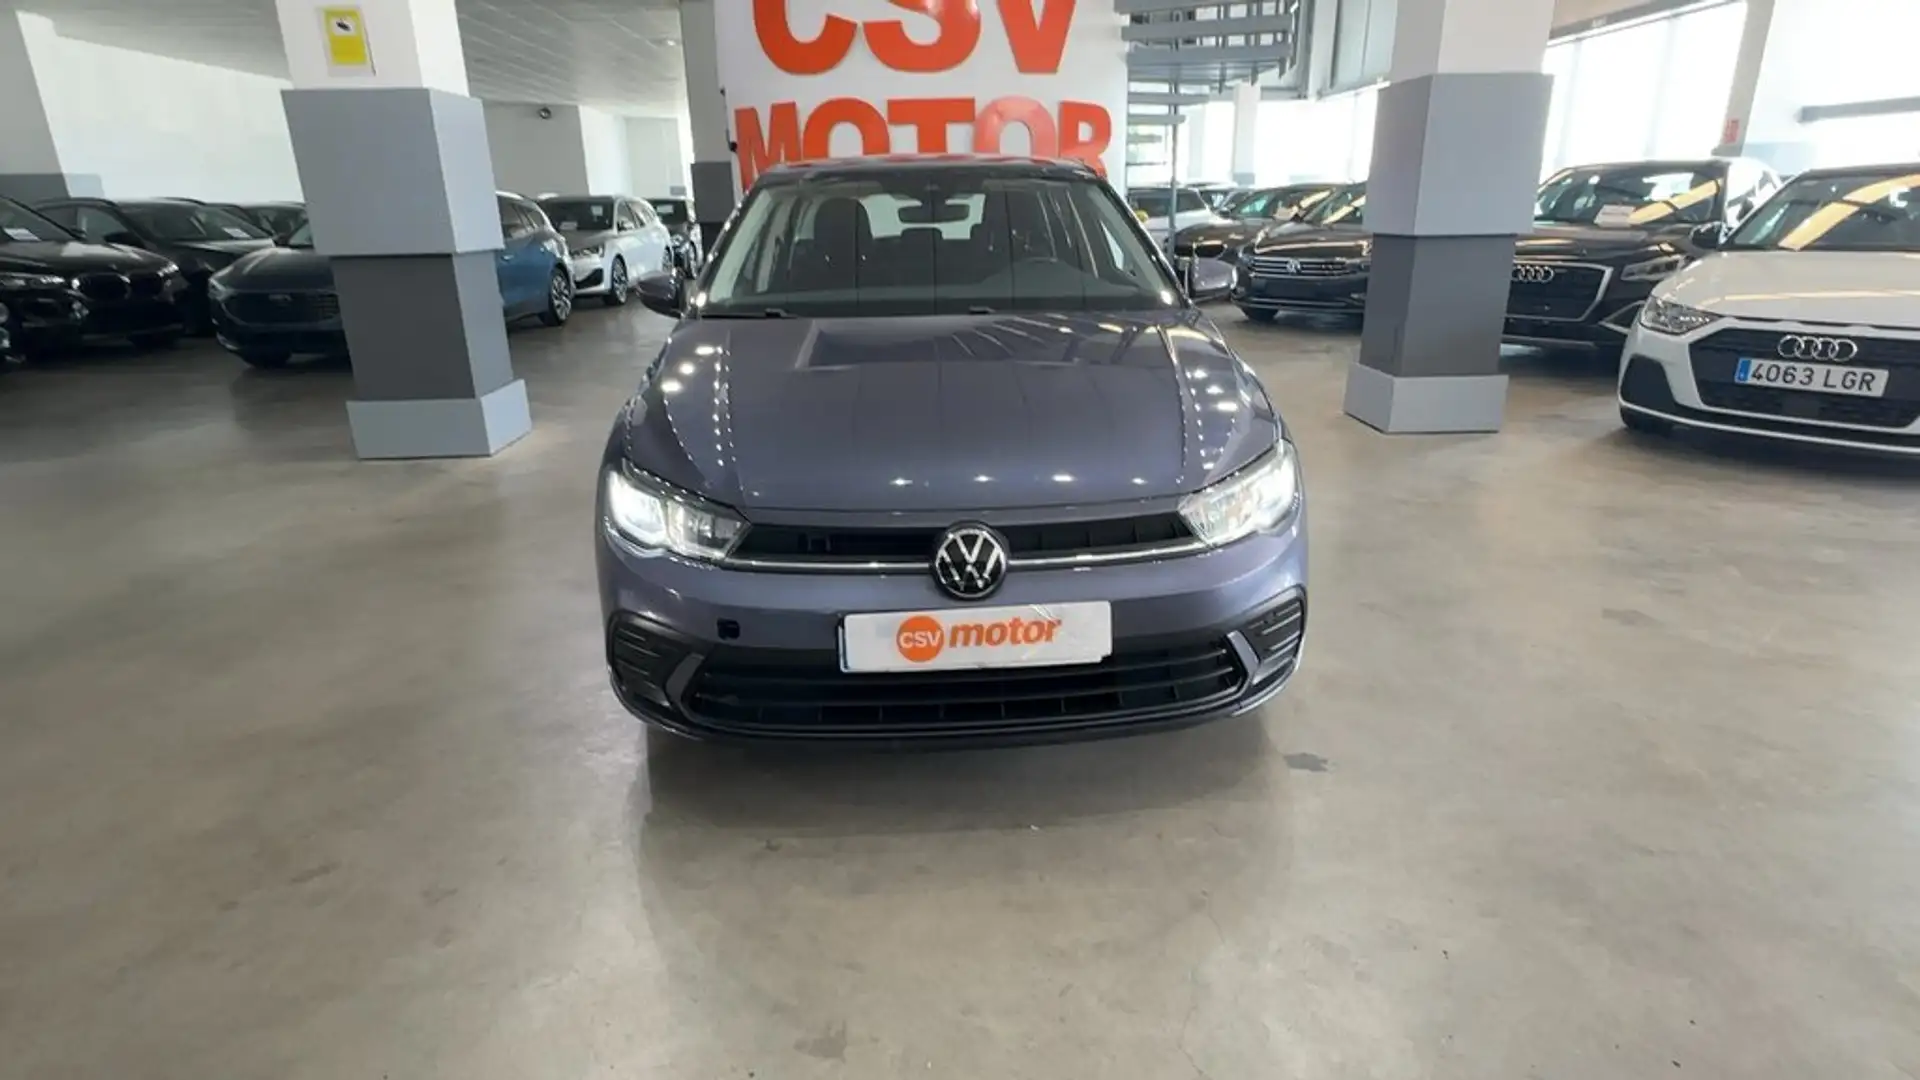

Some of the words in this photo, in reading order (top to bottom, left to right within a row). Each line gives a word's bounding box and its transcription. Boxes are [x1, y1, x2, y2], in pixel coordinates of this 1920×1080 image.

[753, 0, 1077, 75] CSV
[735, 96, 1112, 194] MOTOR
[1751, 362, 1815, 386] 4063
[1823, 368, 1877, 392] LGR
[898, 629, 942, 649] CSV
[949, 616, 1062, 648] motor
